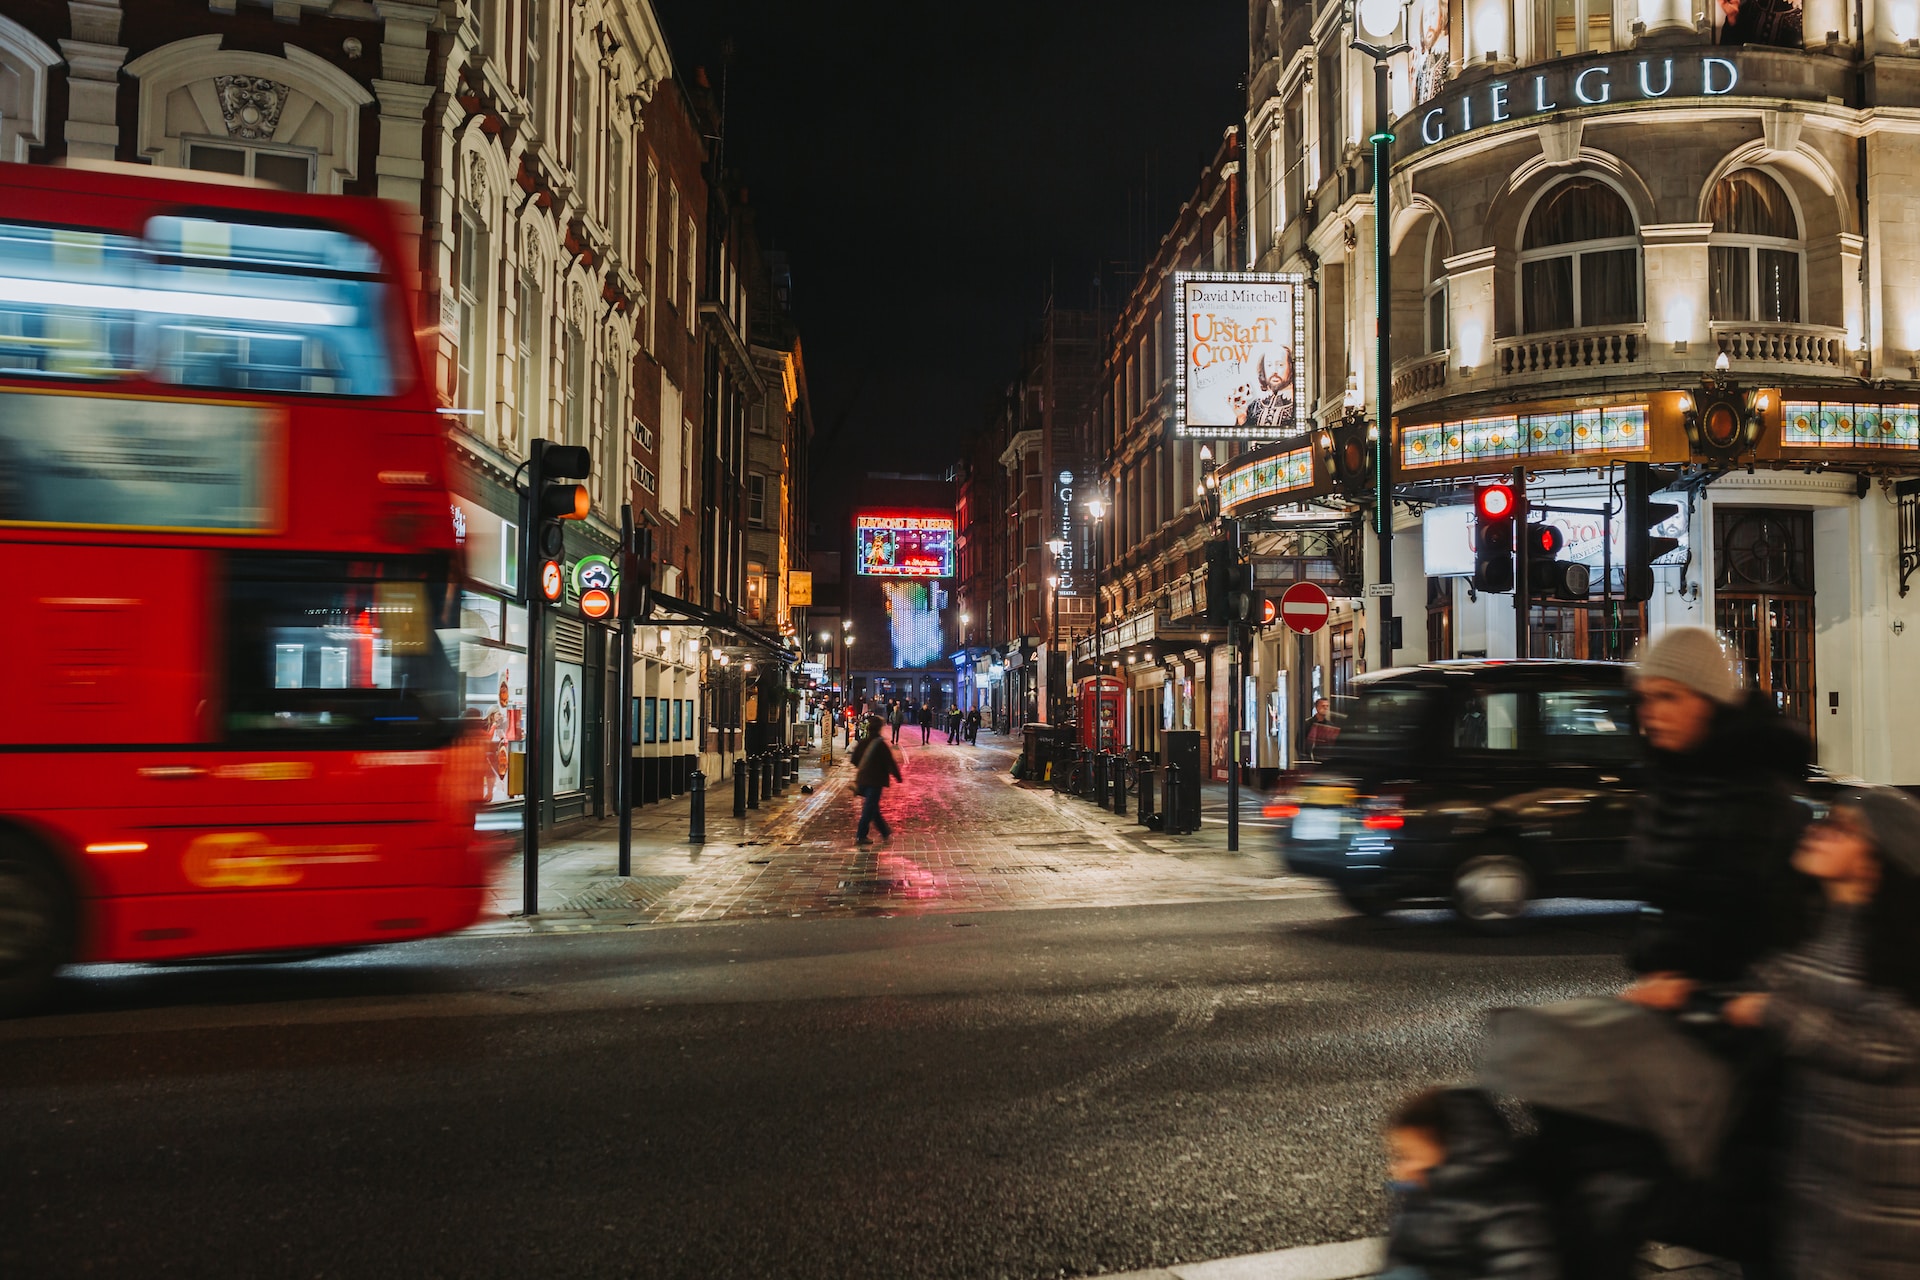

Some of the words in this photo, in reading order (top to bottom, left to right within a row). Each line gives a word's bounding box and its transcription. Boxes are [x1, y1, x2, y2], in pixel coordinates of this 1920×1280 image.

[1422, 58, 1738, 145] GIELGUD
[1191, 289, 1228, 302] David
[1232, 289, 1288, 303] Mitchell
[635, 420, 651, 451] APOLLO
[1060, 488, 1073, 589] GIELGUD
